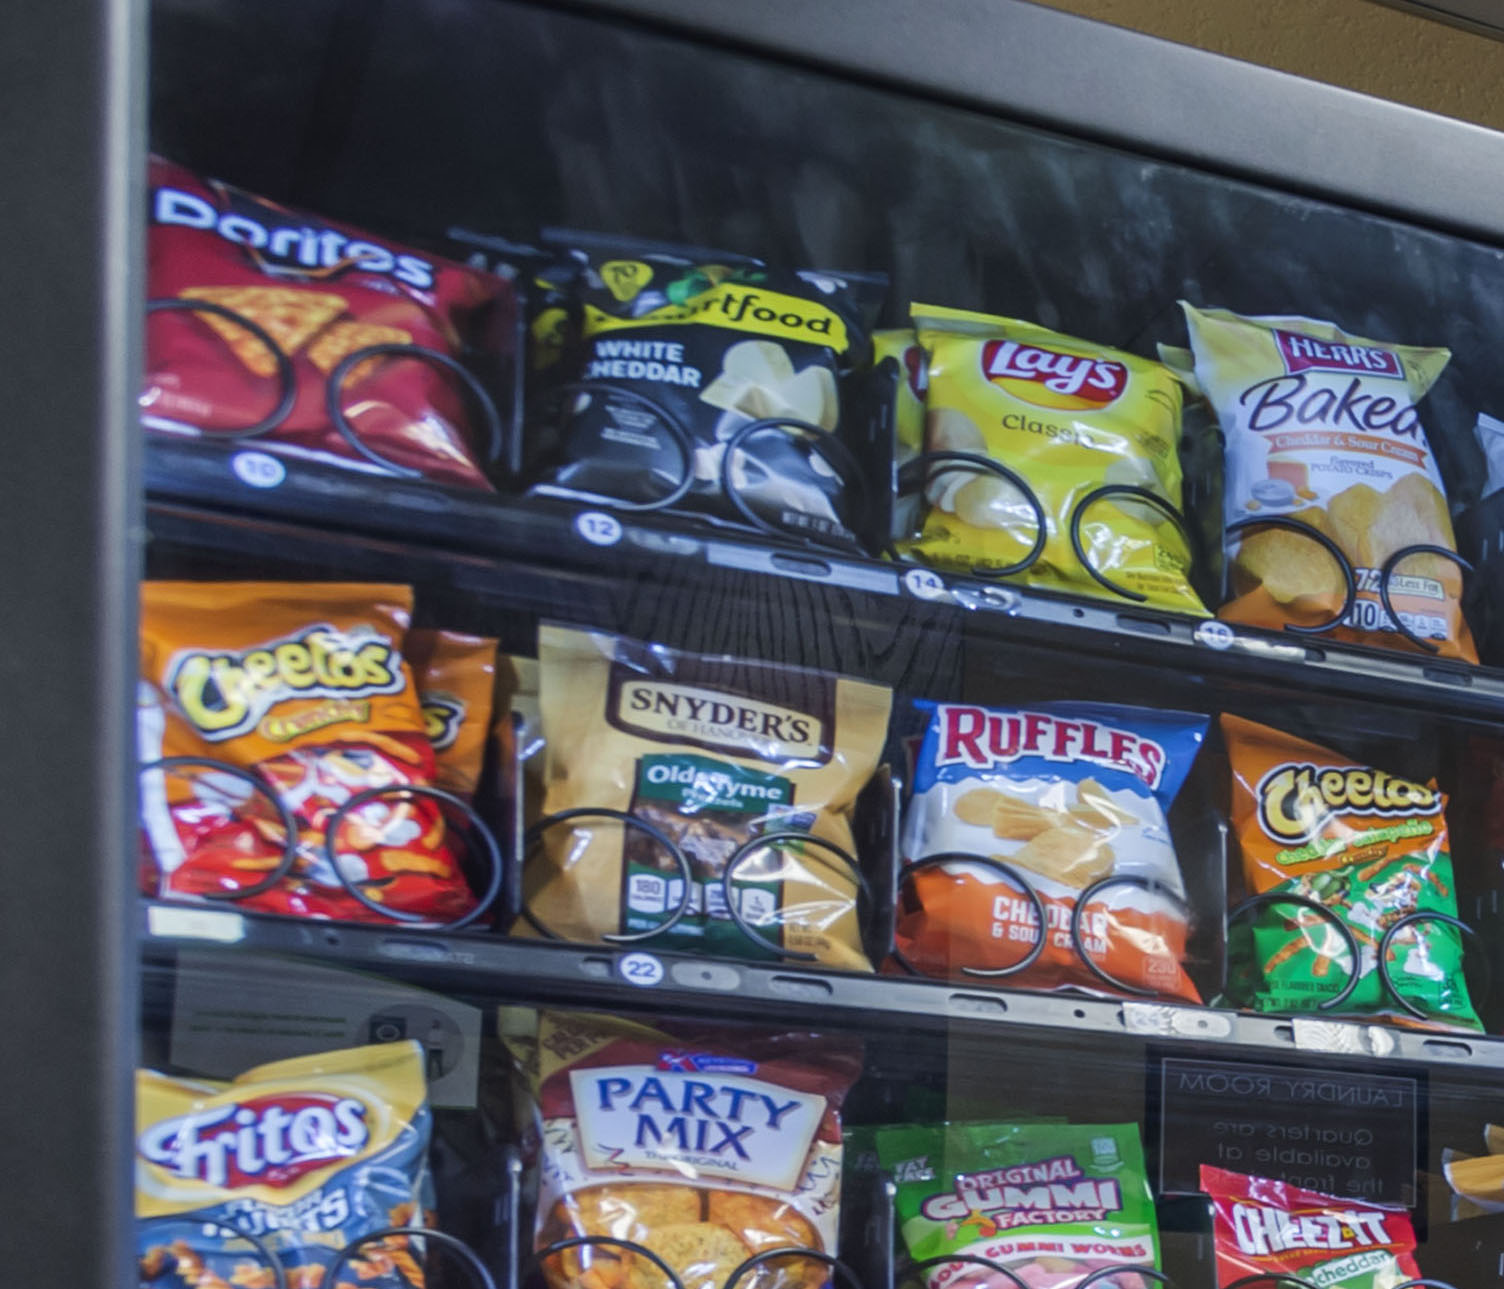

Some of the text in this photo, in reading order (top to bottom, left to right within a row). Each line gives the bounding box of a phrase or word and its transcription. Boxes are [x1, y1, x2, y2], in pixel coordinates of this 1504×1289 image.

[154, 187, 434, 289] Doritos
[596, 340, 684, 363] WHITE
[989, 340, 1121, 394] Lay's
[1288, 336, 1388, 370] HERR'S
[585, 516, 614, 537] 12
[910, 575, 936, 589] 14
[170, 628, 395, 735] Cheetos
[630, 687, 811, 744] SNYDER'S
[942, 706, 1163, 789] RUFFLES
[647, 764, 696, 784] Old
[1259, 763, 1442, 842] Cheetos
[1009, 925, 1046, 944] SOU
[1053, 932, 1108, 955] CRAM
[628, 960, 657, 978] 22
[596, 1076, 802, 1130] PARTY
[139, 1097, 369, 1188] Fritos
[634, 1113, 754, 1161] MIX
[957, 1158, 1082, 1192] ORIGINAL
[923, 1180, 1121, 1220] GUMMI
[995, 1208, 1106, 1230] FACTORY
[985, 1241, 1147, 1259] GUMMI WORMS
[1315, 1250, 1394, 1287] cheddar
